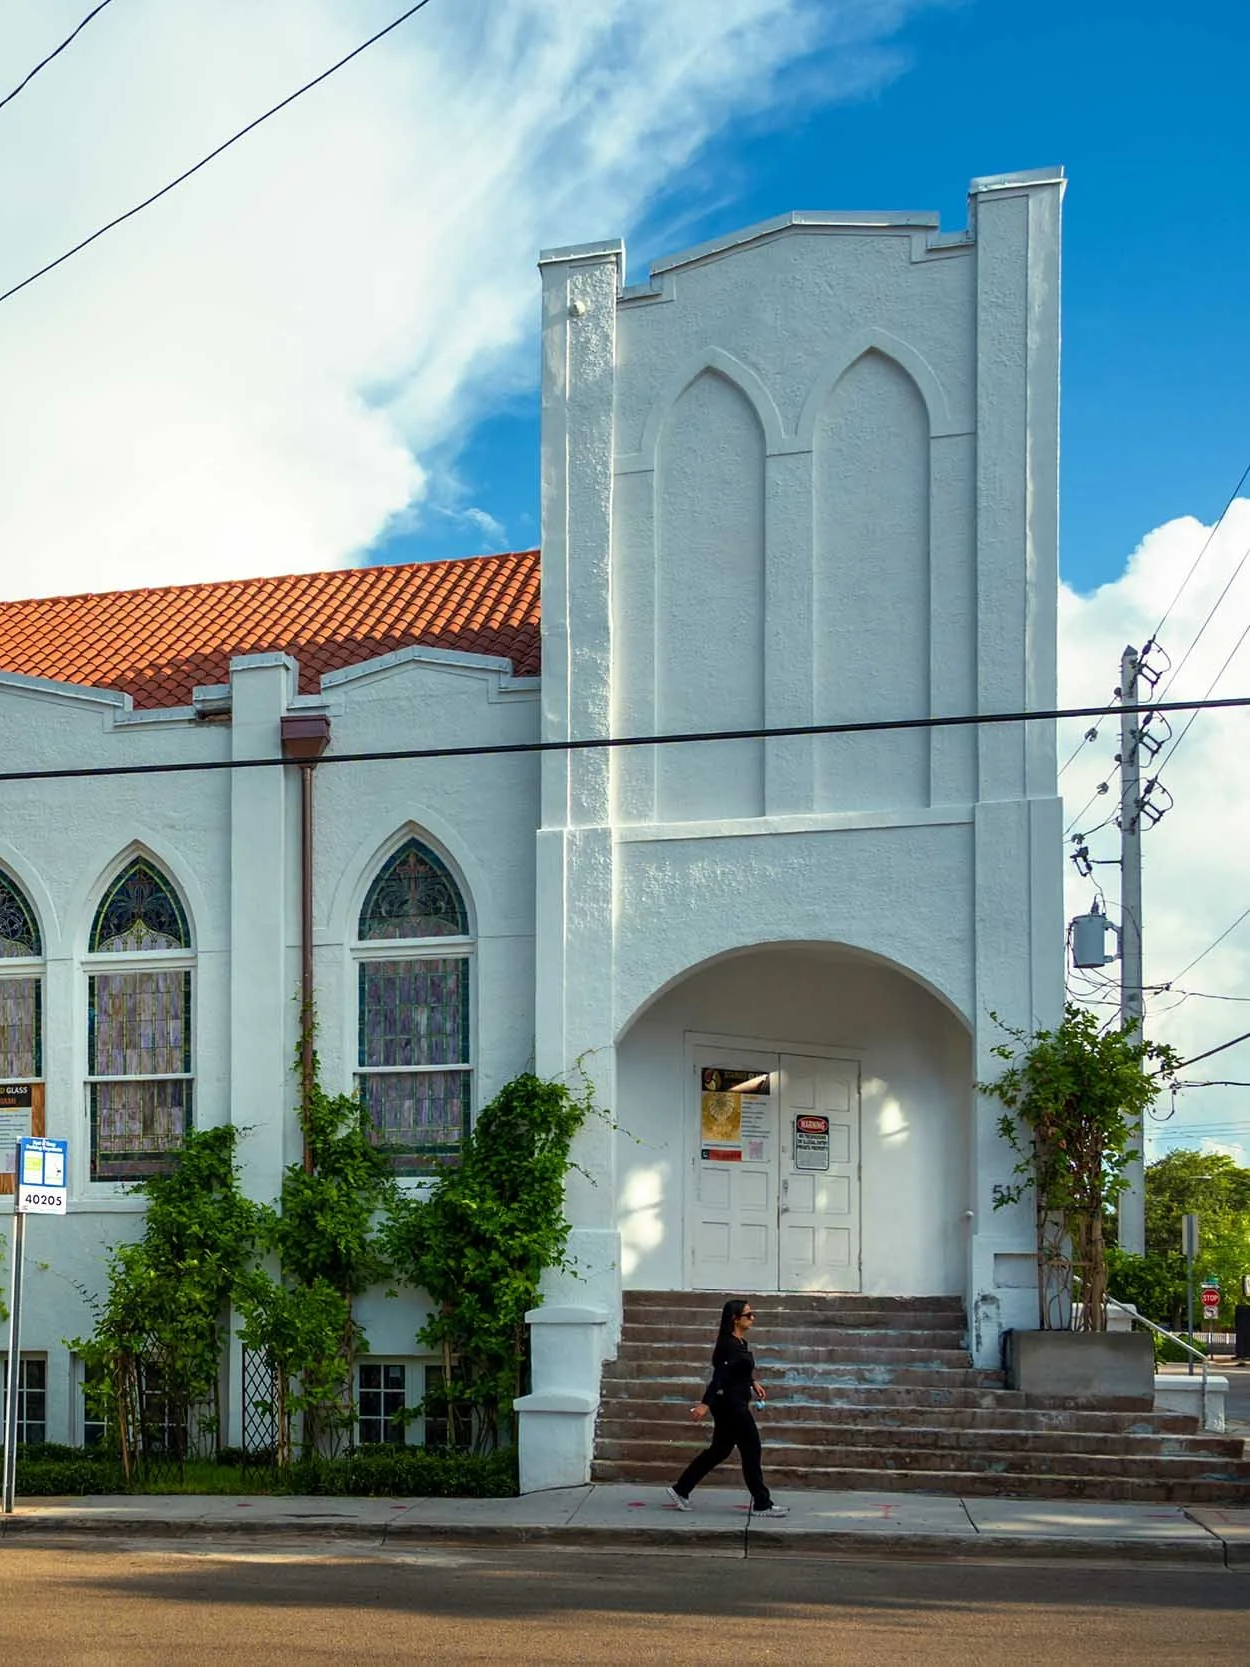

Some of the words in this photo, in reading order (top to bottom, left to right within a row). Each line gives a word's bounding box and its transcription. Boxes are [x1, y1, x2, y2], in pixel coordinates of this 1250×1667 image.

[6, 1086, 28, 1094] GLASS
[800, 1120, 826, 1130] WARNING
[25, 1194, 62, 1206] 40205
[1202, 1294, 1218, 1302] STOP
